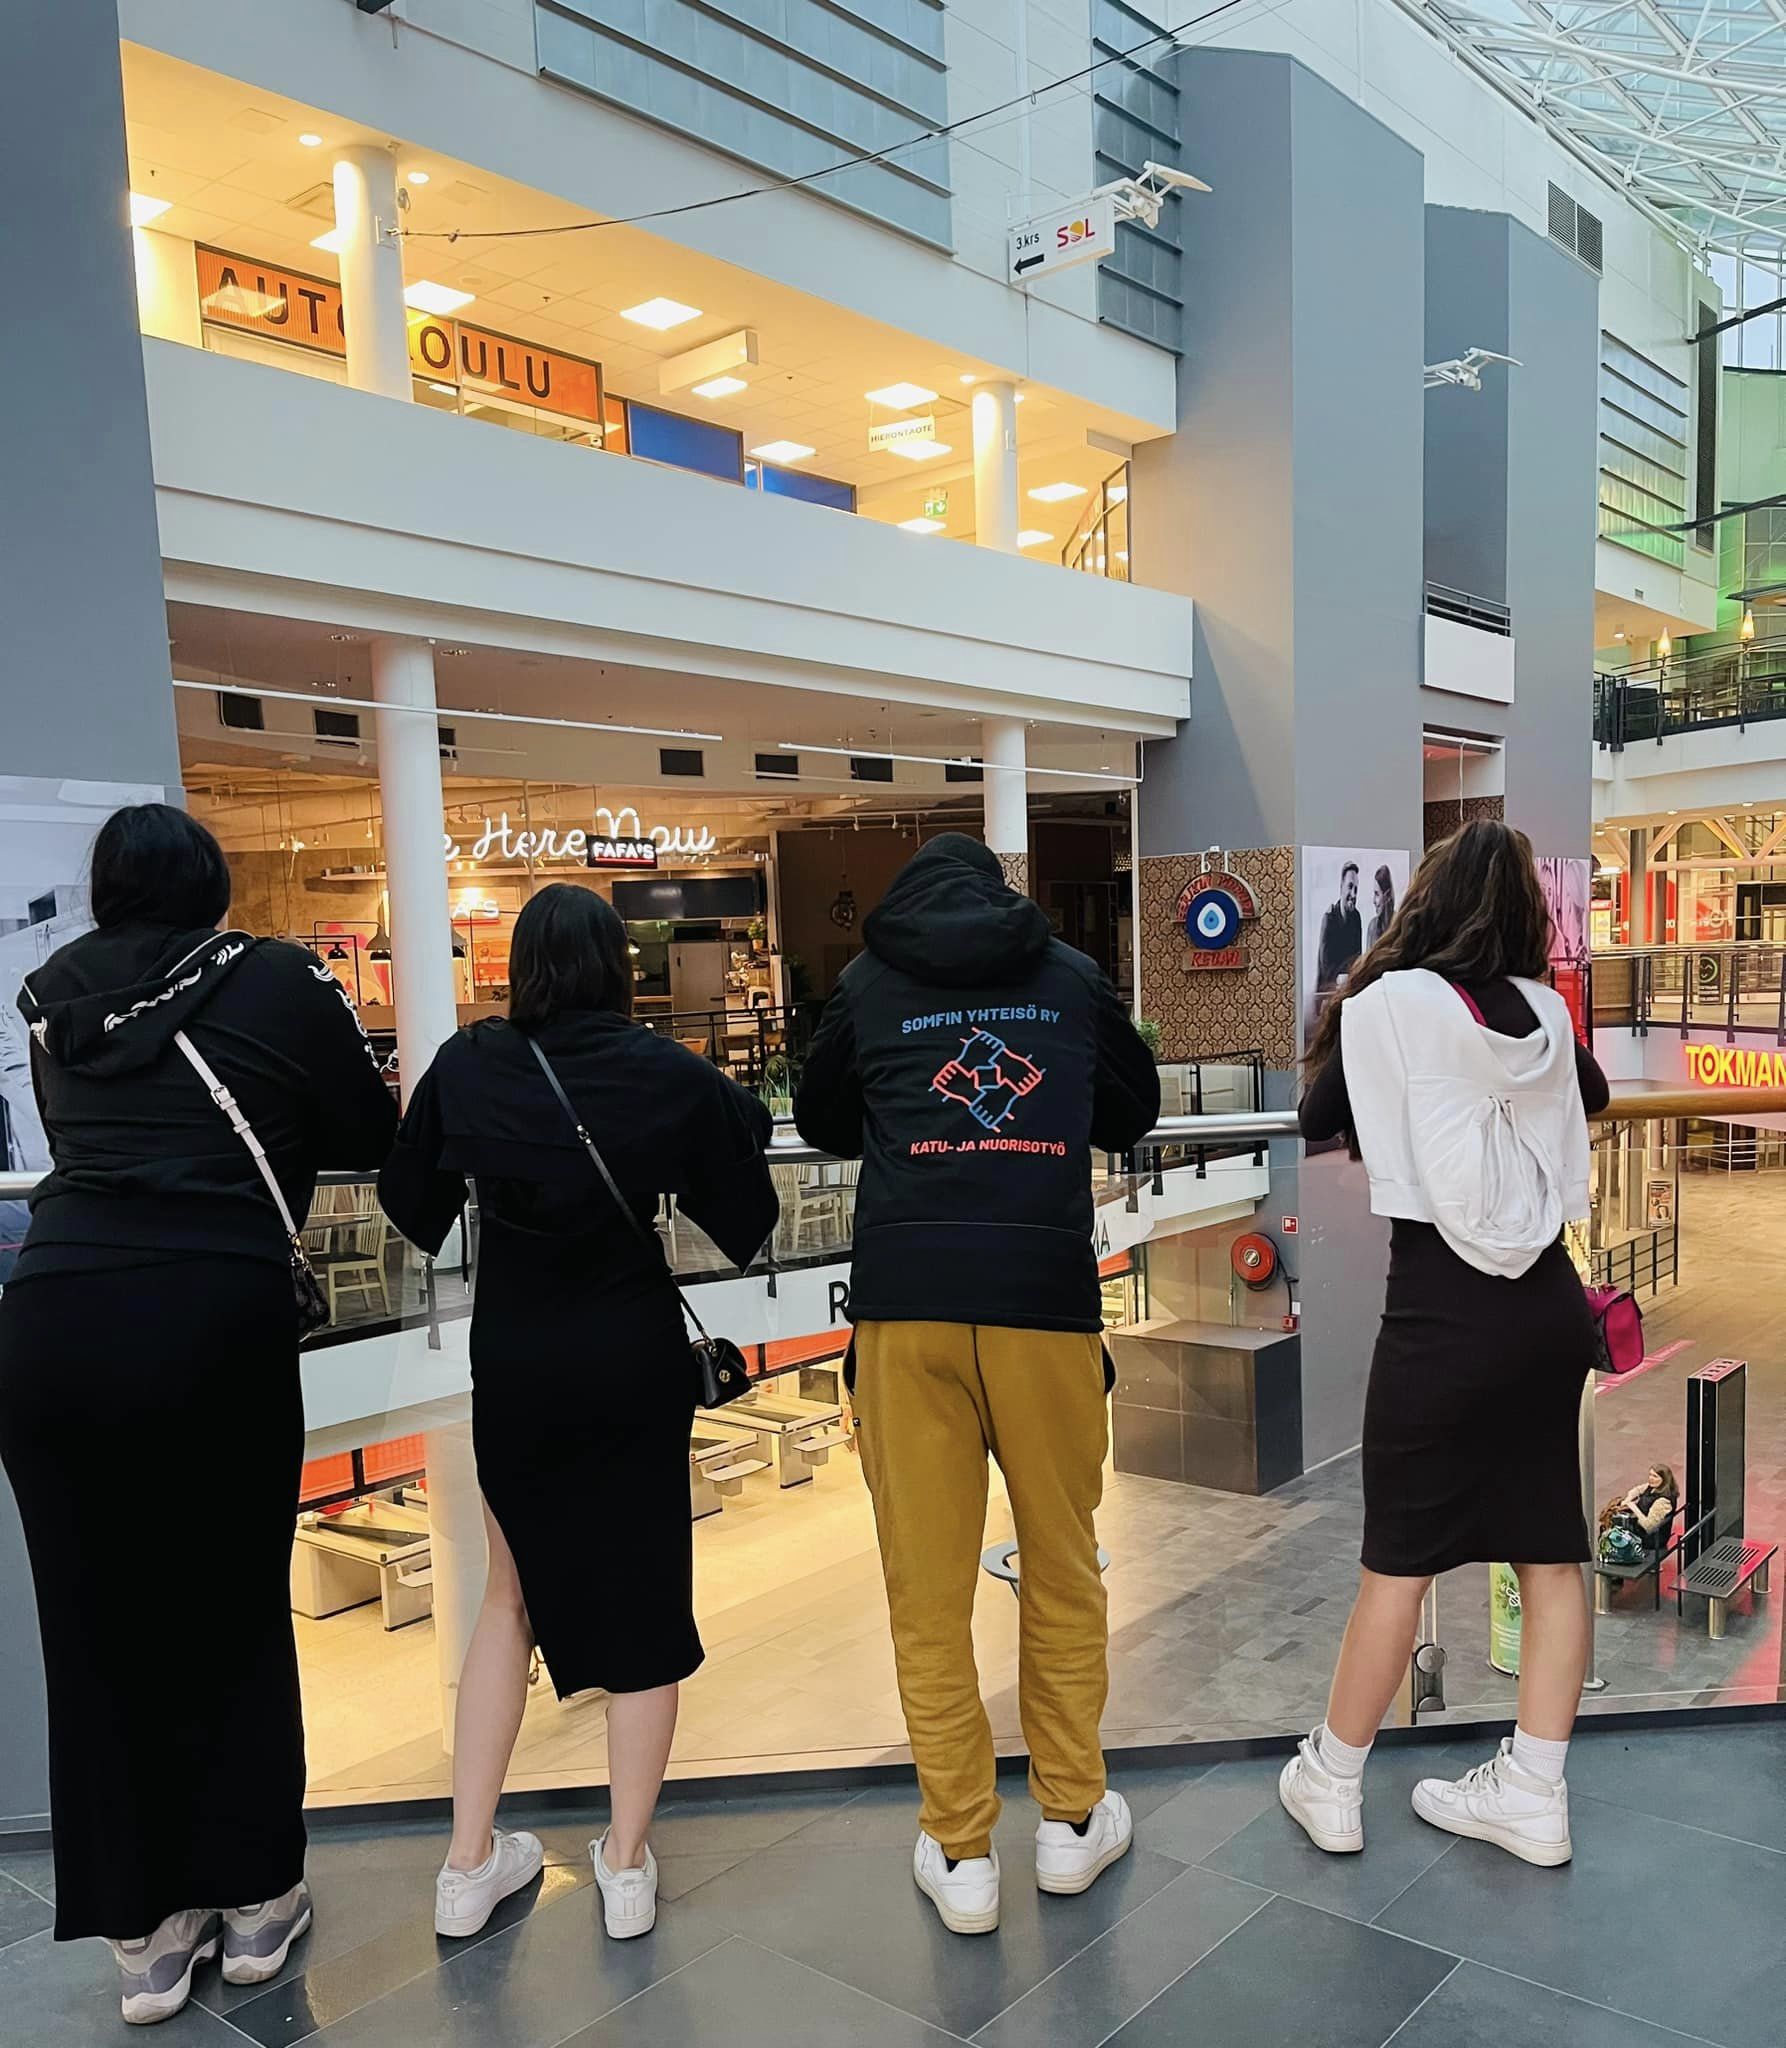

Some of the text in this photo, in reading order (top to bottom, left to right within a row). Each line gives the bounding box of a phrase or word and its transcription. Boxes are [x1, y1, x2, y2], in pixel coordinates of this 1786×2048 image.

[1056, 218, 1095, 248] SOL
[217, 267, 551, 398] AUTOULU
[472, 811, 588, 860] Here
[592, 842, 655, 859] FAFA'S
[902, 1004, 1060, 1034] SOMFIN YHTEISÖ RY
[910, 1139, 1066, 1156] KATU- JA NUORISOTYÖ
